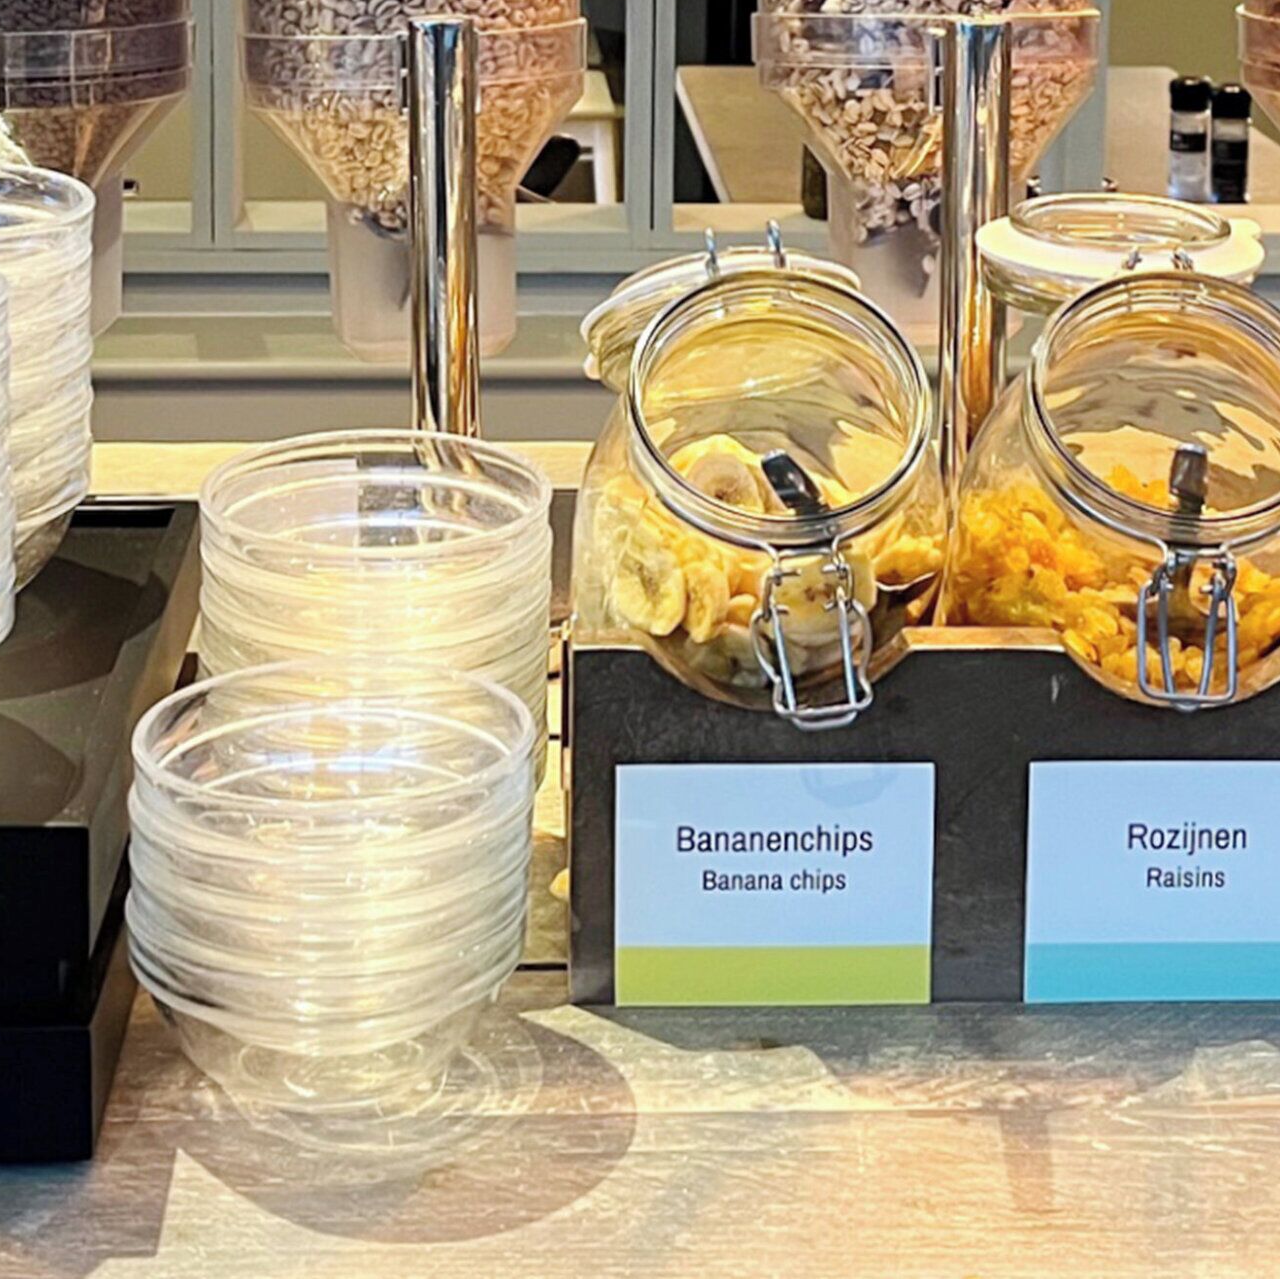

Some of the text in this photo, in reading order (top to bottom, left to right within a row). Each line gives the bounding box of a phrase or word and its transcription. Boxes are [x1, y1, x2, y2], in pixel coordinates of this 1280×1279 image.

[676, 824, 874, 858] Bananenchips
[1127, 821, 1247, 857] Rozijnen
[702, 868, 847, 895] Banana chips
[1146, 866, 1225, 889] Raisins
